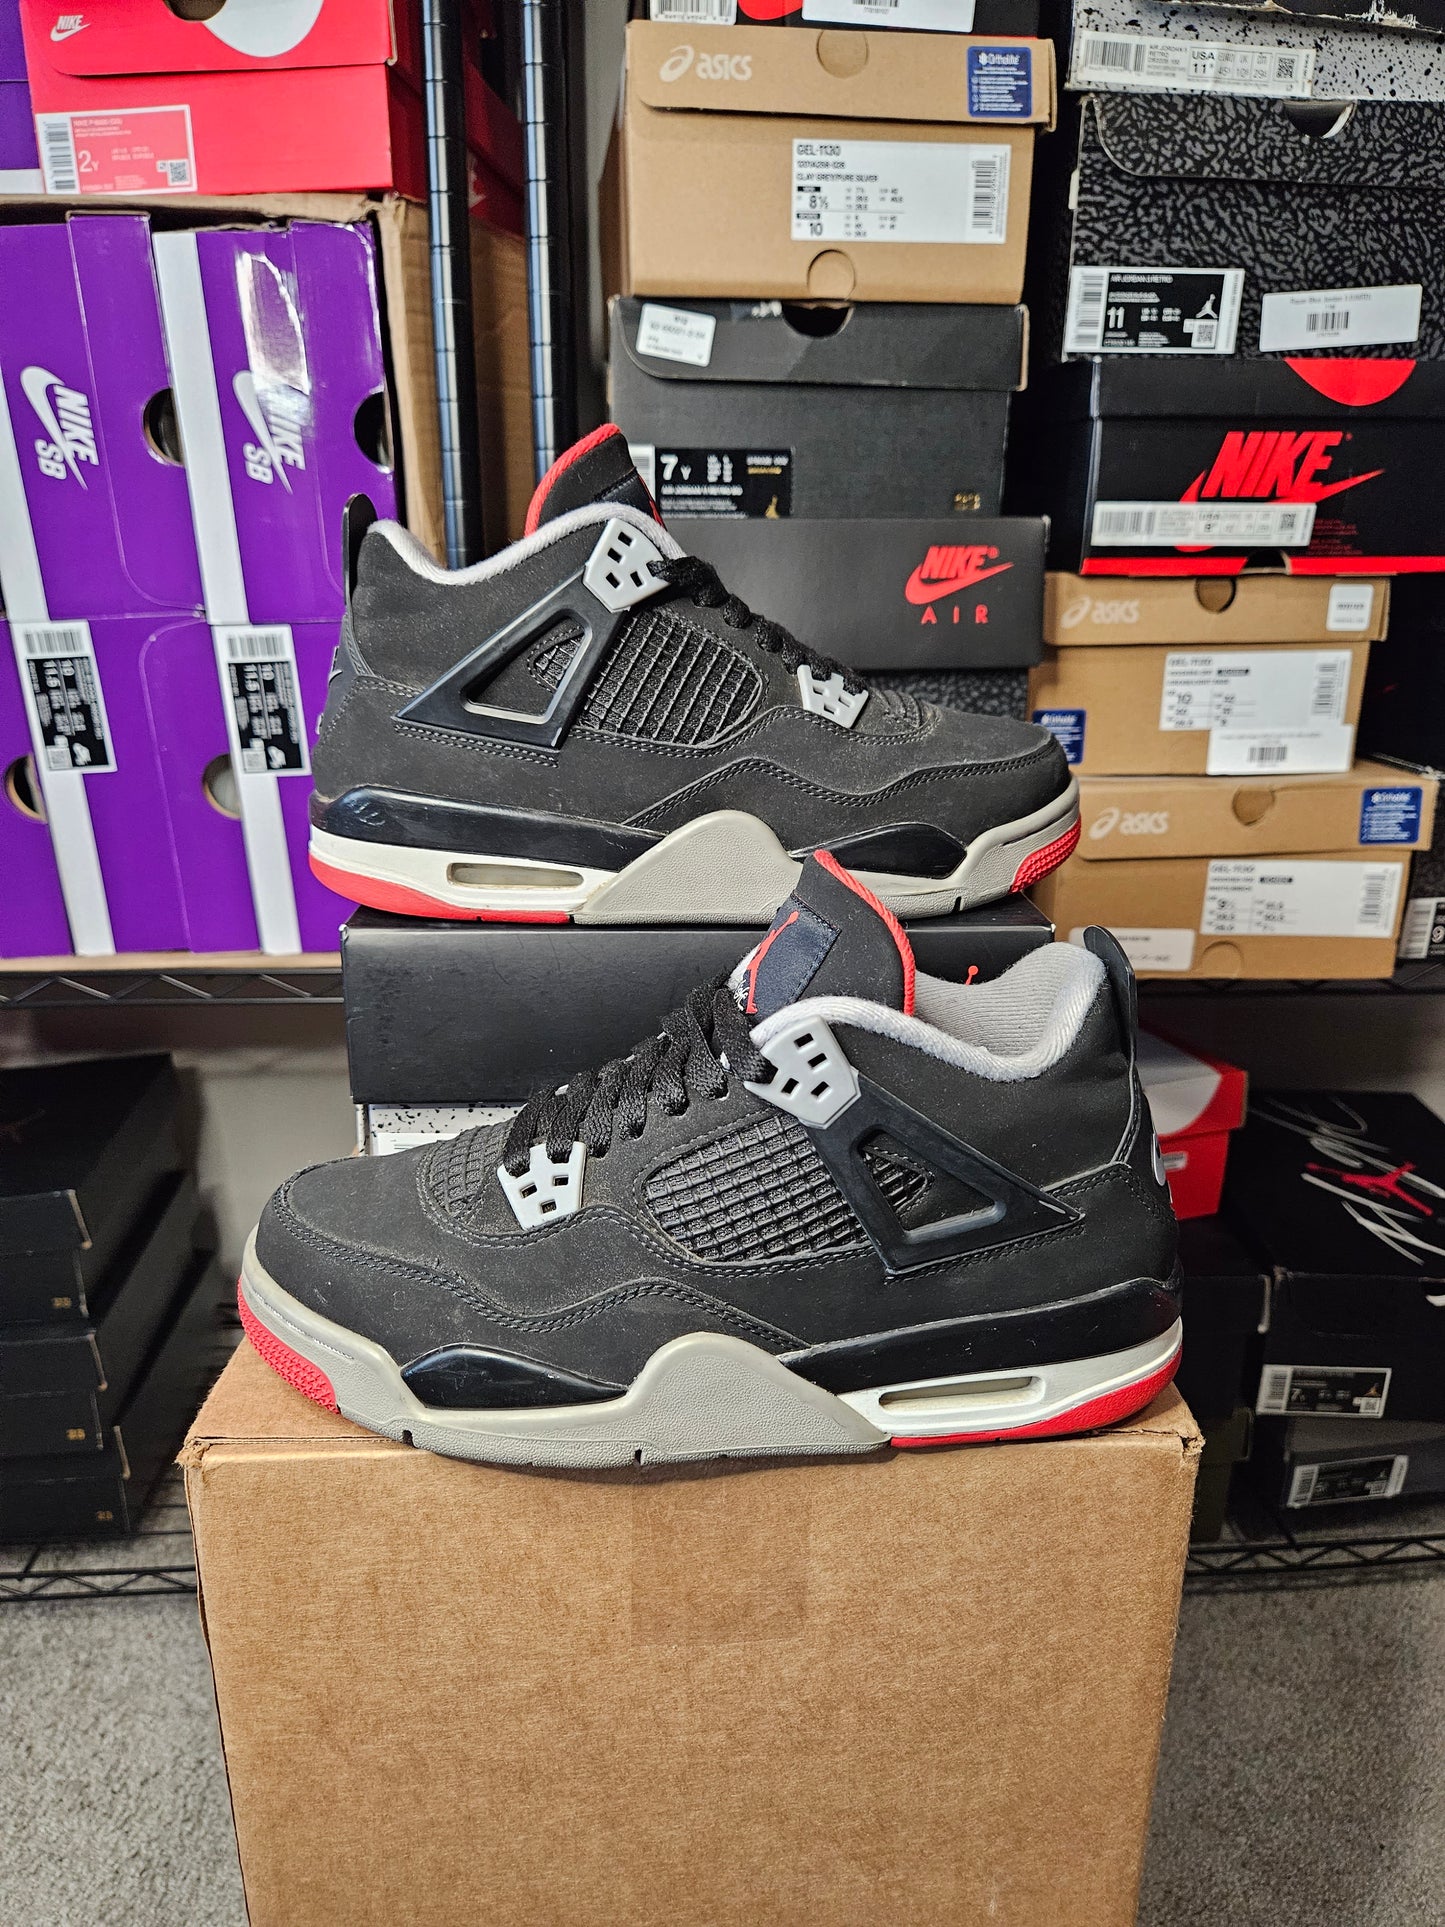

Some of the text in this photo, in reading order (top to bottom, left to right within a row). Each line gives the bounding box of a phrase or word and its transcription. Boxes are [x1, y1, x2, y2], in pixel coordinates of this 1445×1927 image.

[57, 15, 83, 30] NIKE
[695, 53, 752, 81] asics
[1192, 50, 1215, 61] USA
[809, 223, 823, 237] 10
[1106, 306, 1125, 329] 11
[53, 383, 100, 466] NIKE
[34, 439, 67, 480] SB
[243, 442, 274, 484] SB
[1200, 431, 1343, 498] NIKE
[919, 546, 991, 580] NIKE
[920, 604, 990, 625] AIR
[1091, 599, 1139, 624] asics
[1119, 810, 1169, 834] asics
